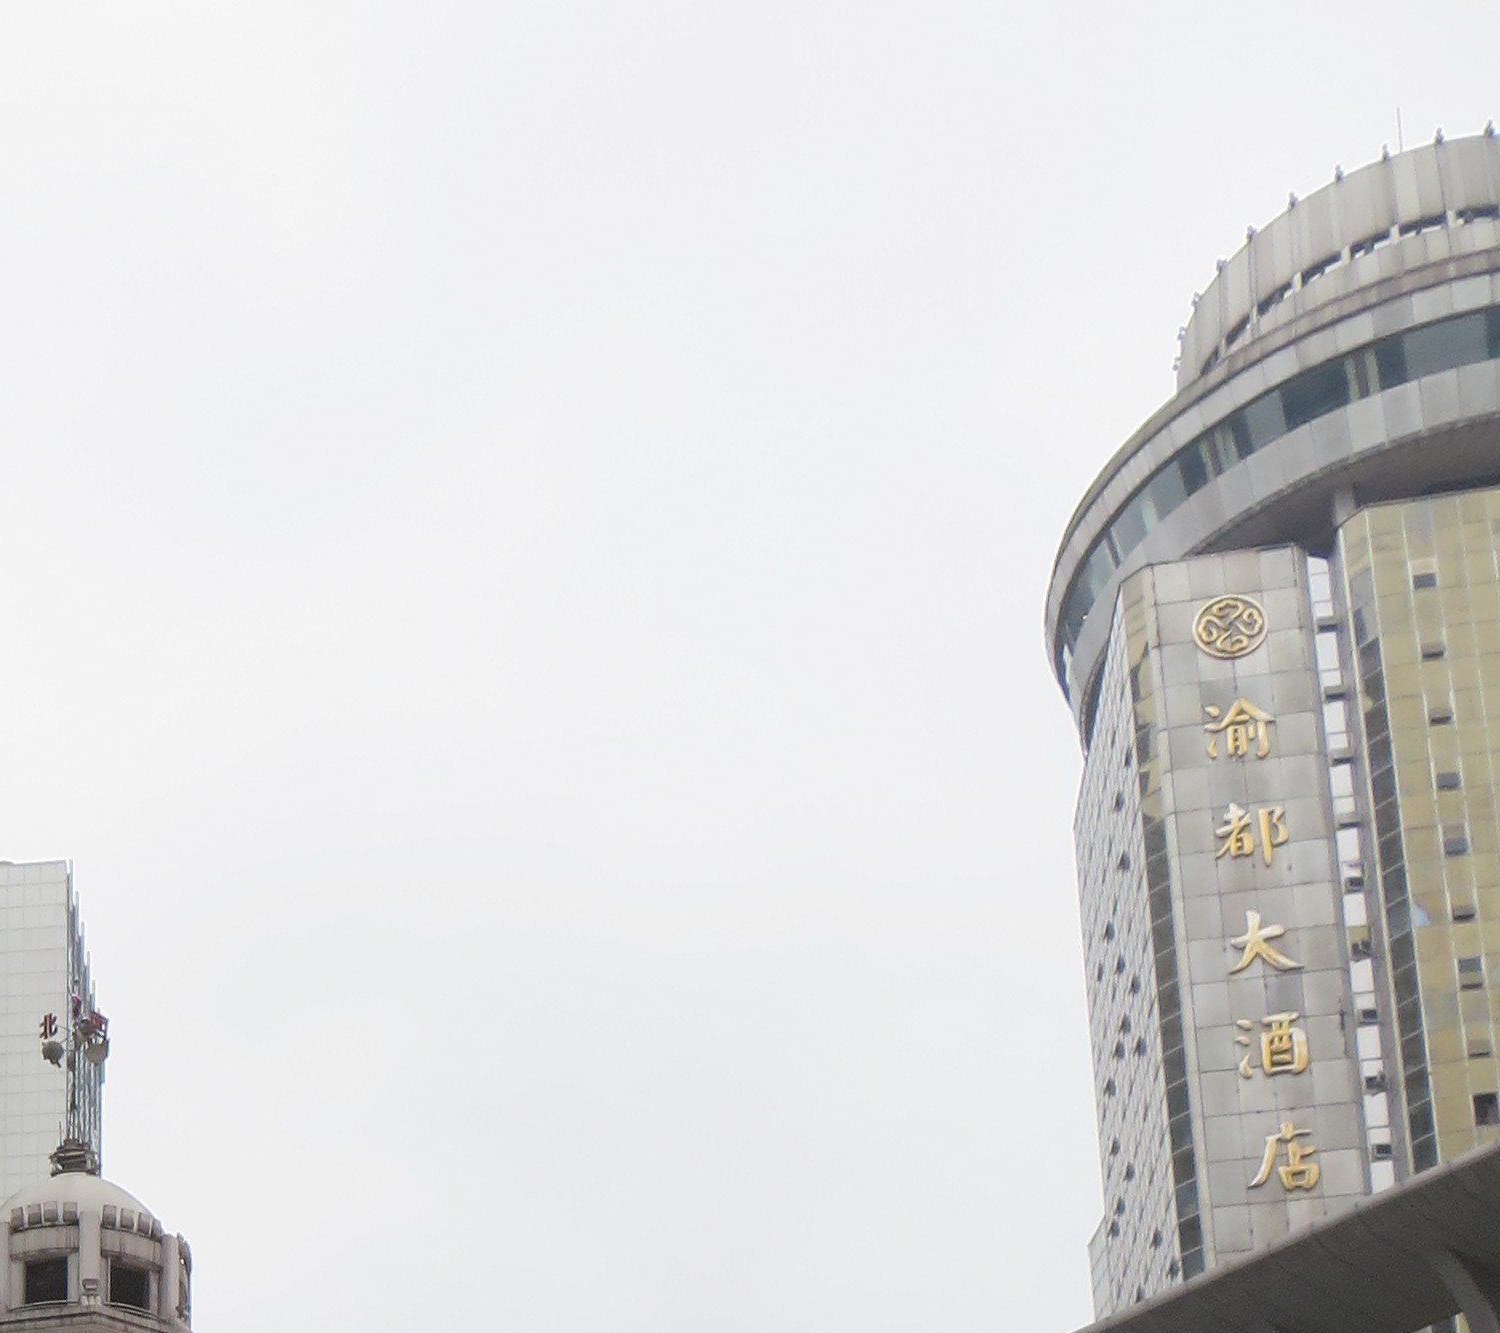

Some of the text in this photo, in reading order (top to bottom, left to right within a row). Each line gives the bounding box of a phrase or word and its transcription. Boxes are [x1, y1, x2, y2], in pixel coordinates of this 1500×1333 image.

[39, 1013, 58, 1040] 北
[1204, 697, 1321, 1192] 渝都大酒店
